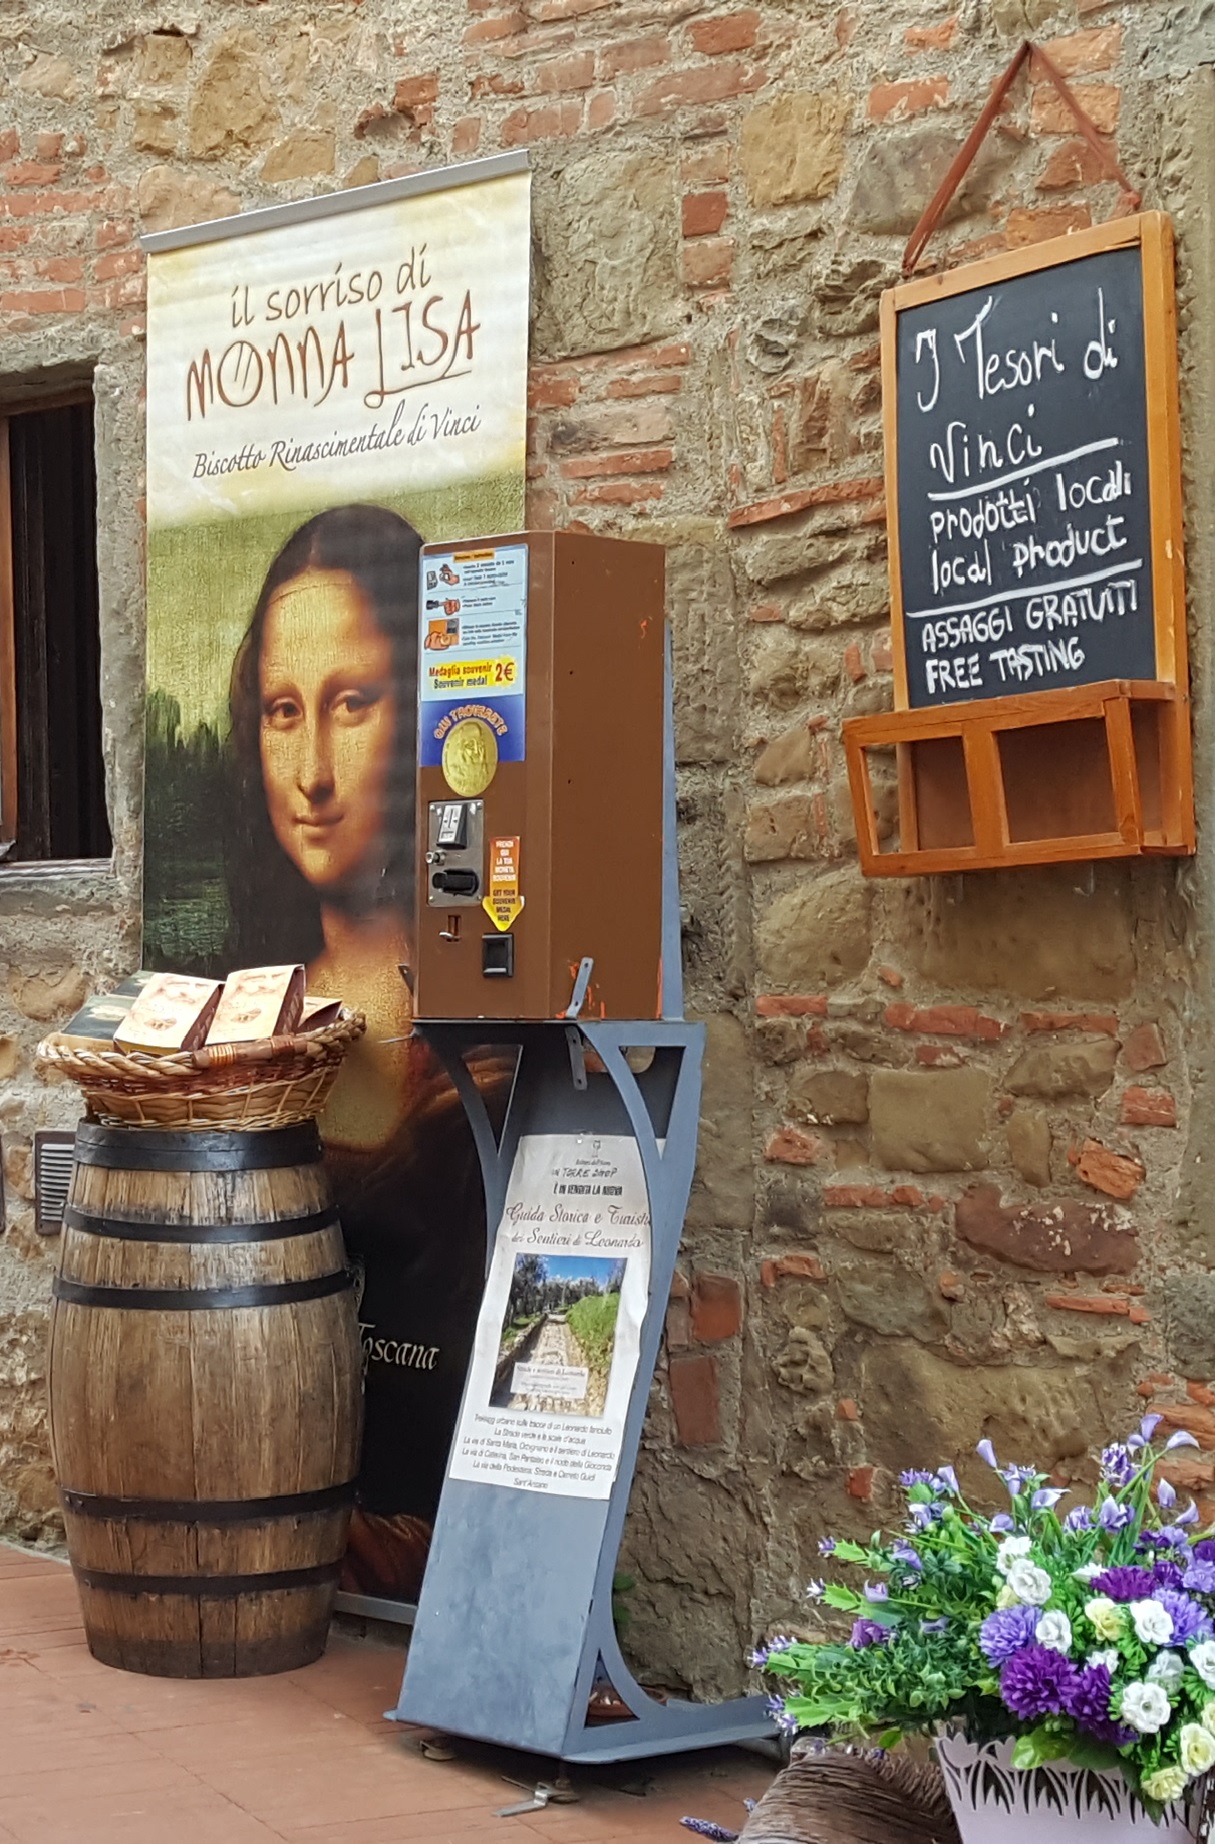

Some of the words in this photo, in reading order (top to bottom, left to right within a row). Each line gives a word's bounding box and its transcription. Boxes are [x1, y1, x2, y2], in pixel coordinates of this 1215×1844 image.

[231, 285, 255, 328] il
[265, 262, 383, 322] sorriso
[396, 243, 432, 293] di
[364, 289, 482, 409] LISA
[953, 295, 1066, 400] Tesori
[1083, 287, 1119, 381] di
[192, 444, 267, 479] Biscotto
[269, 398, 406, 472] Rinascimentale
[407, 403, 429, 446] di
[430, 404, 482, 440] Vinci
[929, 403, 1043, 484] Vinci
[1055, 461, 1132, 511] locali
[931, 538, 992, 595] local
[1012, 514, 1128, 579] product
[921, 605, 1014, 653] ASSAGGI
[1026, 579, 1138, 631] GRATUITI
[428, 664, 460, 678] Medaglia
[463, 662, 493, 675] souvenir
[434, 676, 465, 689] Souvenir
[466, 675, 488, 686] medal
[495, 662, 515, 682] 2€
[925, 652, 984, 694] FREE
[989, 636, 1085, 682] TASTING
[505, 1202, 546, 1226] Guida
[549, 1203, 590, 1224] Storica
[594, 1212, 602, 1224] e
[584, 1229, 643, 1248] Leonardo
